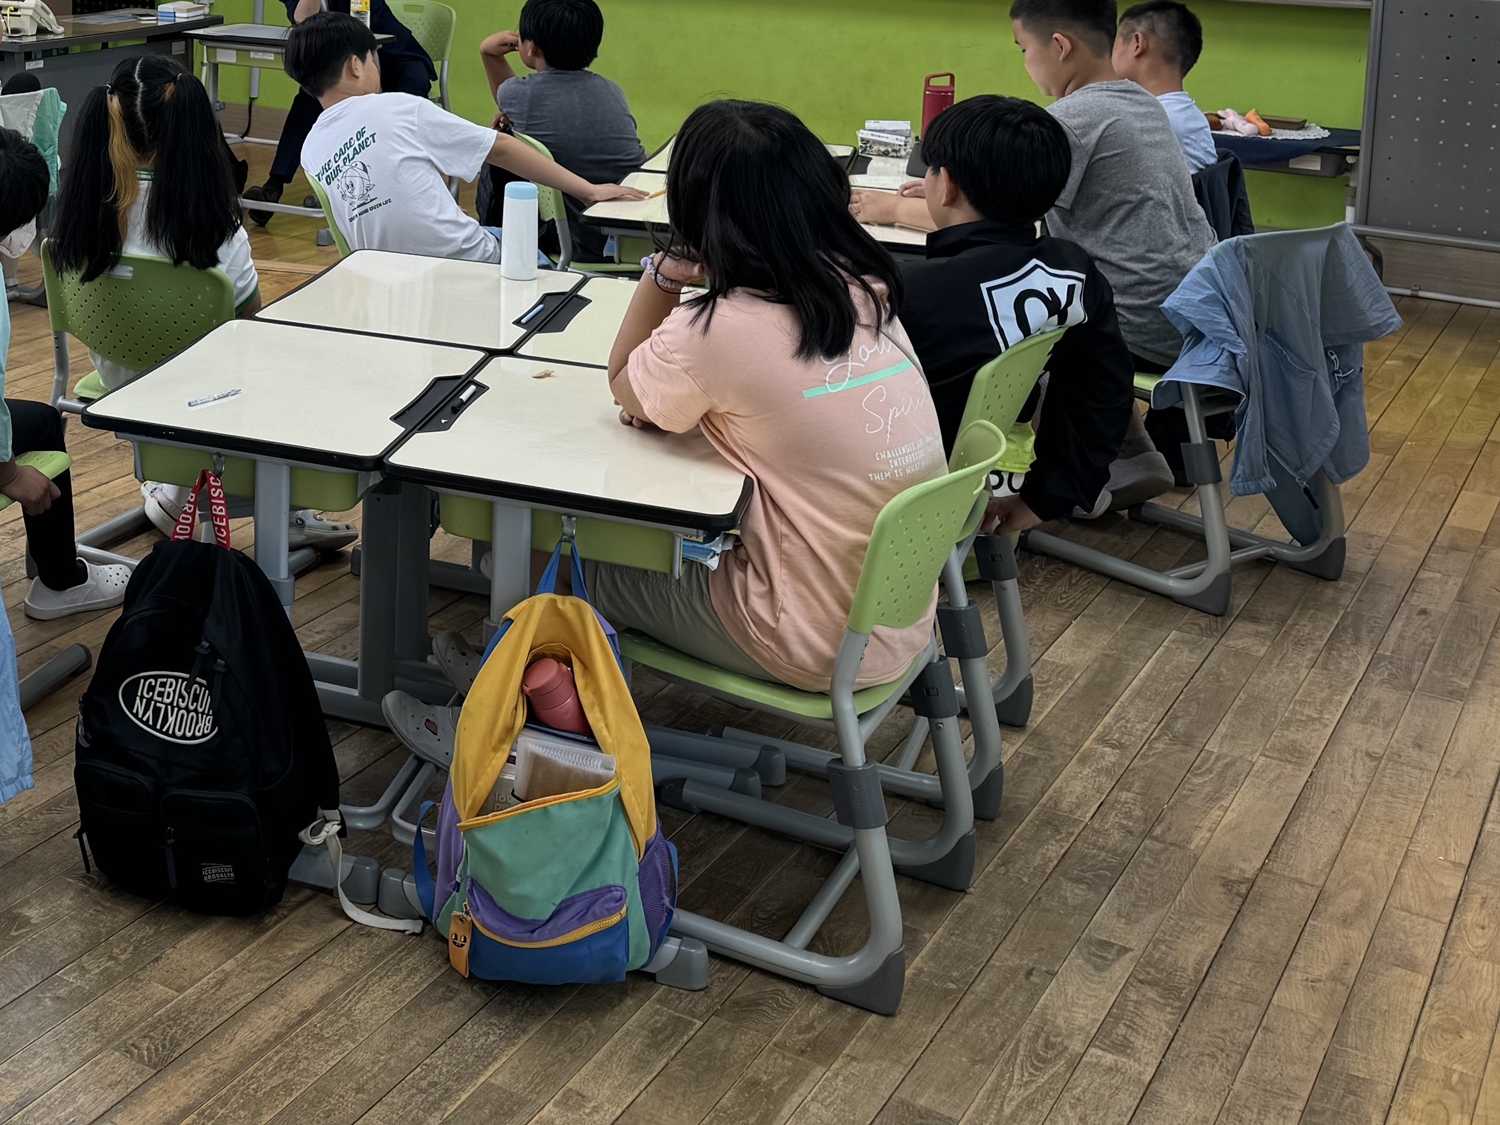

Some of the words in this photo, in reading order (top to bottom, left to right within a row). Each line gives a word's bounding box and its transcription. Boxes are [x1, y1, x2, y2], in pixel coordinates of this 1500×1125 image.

[325, 164, 342, 186] OUR
[342, 132, 377, 166] PLANET
[333, 137, 356, 164] CARE
[355, 126, 367, 142] OF
[210, 476, 227, 545] ICEBISC
[132, 696, 214, 738] BROOKLYN
